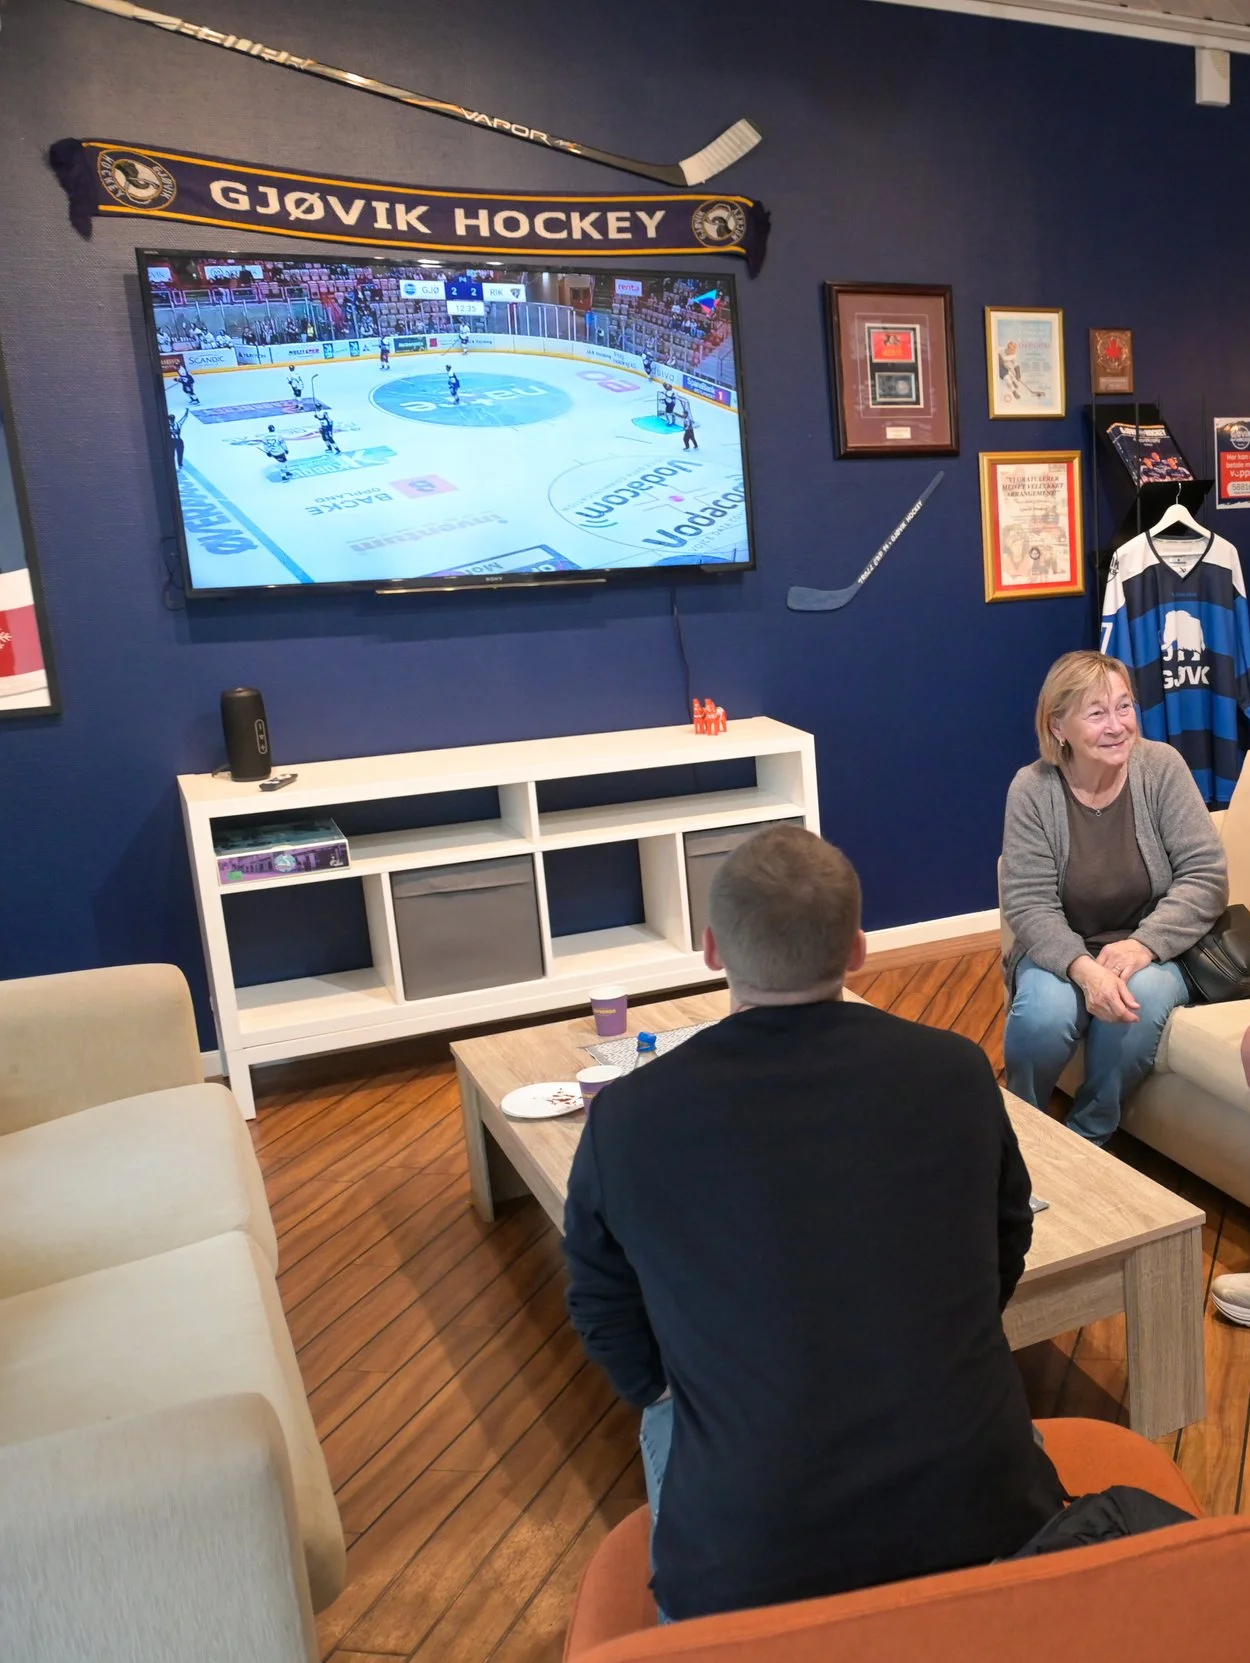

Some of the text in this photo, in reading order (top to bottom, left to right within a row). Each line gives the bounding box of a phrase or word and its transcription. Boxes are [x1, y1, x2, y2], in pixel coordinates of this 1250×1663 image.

[460, 106, 552, 146] VAPOR
[208, 179, 667, 240] GJØVIK HOCKEY
[421, 283, 440, 294] GJØ
[451, 287, 458, 296] 2
[471, 288, 477, 296] 2
[489, 288, 504, 296] RIK
[617, 282, 640, 292] renta
[304, 492, 394, 516] BACKE
[905, 499, 923, 523] HOCKEY
[642, 482, 745, 549] Vodaco
